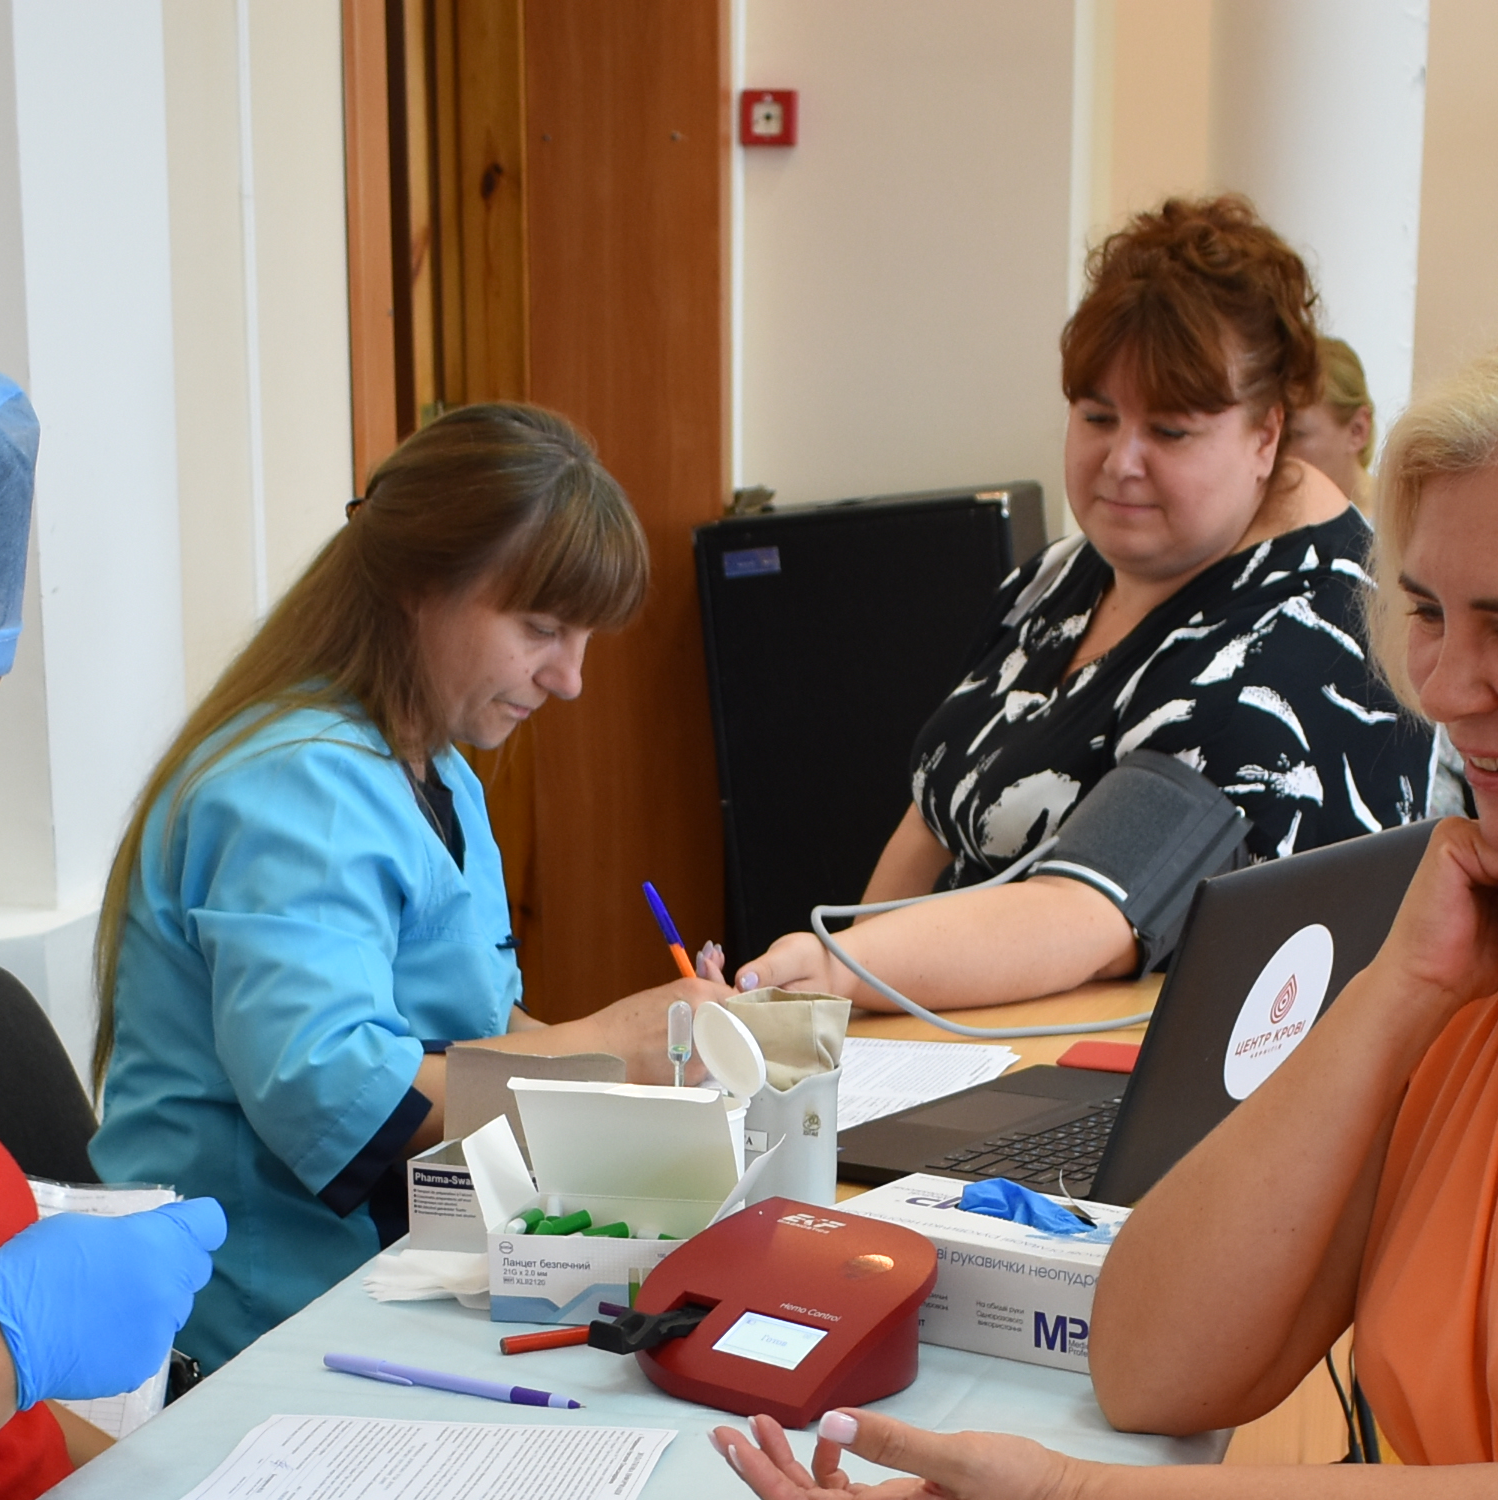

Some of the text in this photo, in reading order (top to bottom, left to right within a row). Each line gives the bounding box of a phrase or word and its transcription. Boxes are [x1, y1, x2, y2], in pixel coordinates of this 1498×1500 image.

[1235, 1031, 1272, 1057] ЦЕНТР
[1272, 1019, 1306, 1043] КРОВІ
[414, 1171, 473, 1186] Pharma-Swa
[502, 1257, 591, 1271] Ланцет безпечний
[951, 1249, 1025, 1275] рукавички
[503, 1268, 518, 1276] 21G
[780, 1303, 842, 1322] Hemo Control
[1068, 1346, 1089, 1358] Profe
